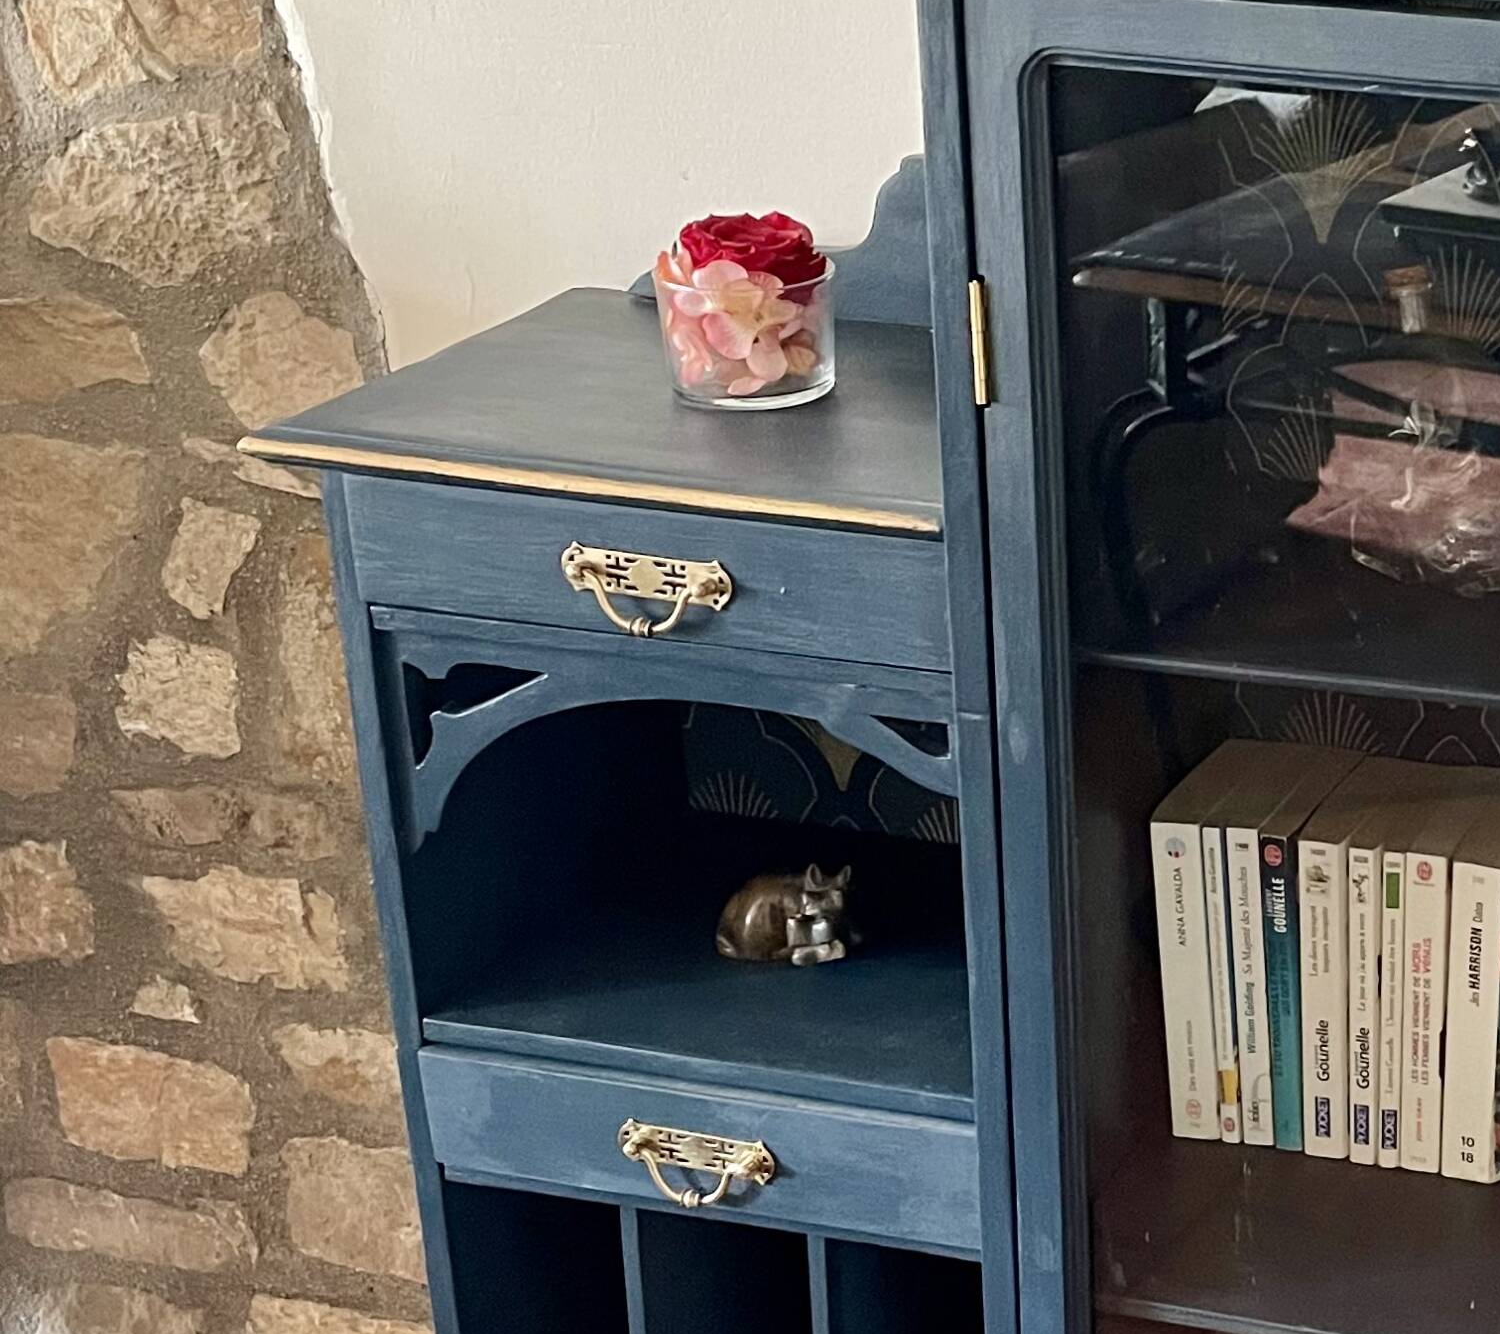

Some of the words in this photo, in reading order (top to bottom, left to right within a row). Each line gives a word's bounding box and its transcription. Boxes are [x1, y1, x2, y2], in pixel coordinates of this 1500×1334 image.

[1173, 867, 1185, 913] GAVALDA
[1237, 866, 1249, 907] Mouches
[1239, 909, 1249, 925] des
[1271, 877, 1287, 933] GOUNELLE
[1176, 916, 1186, 947] ANNA
[1241, 927, 1253, 961] Majesté
[1243, 964, 1252, 975] Sa
[1468, 925, 1482, 990] HARRISON
[1244, 981, 1255, 1016] Golding
[1413, 976, 1420, 988] DE
[1423, 978, 1430, 989] DE
[1412, 990, 1420, 1028] VIENNENT
[1422, 991, 1430, 1031] VIENNENT
[1246, 1018, 1256, 1053] William
[1315, 1019, 1330, 1082] Gounelle
[1411, 1031, 1419, 1067] HOMMES
[1421, 1033, 1429, 1068] FEMMES
[1355, 1027, 1369, 1089] Gounelle
[1315, 1097, 1330, 1137] POCKET
[1354, 1104, 1368, 1144] POCKET
[1382, 1109, 1396, 1149] POCKET
[1460, 1151, 1474, 1164] 18
[1461, 1135, 1475, 1148] 10
